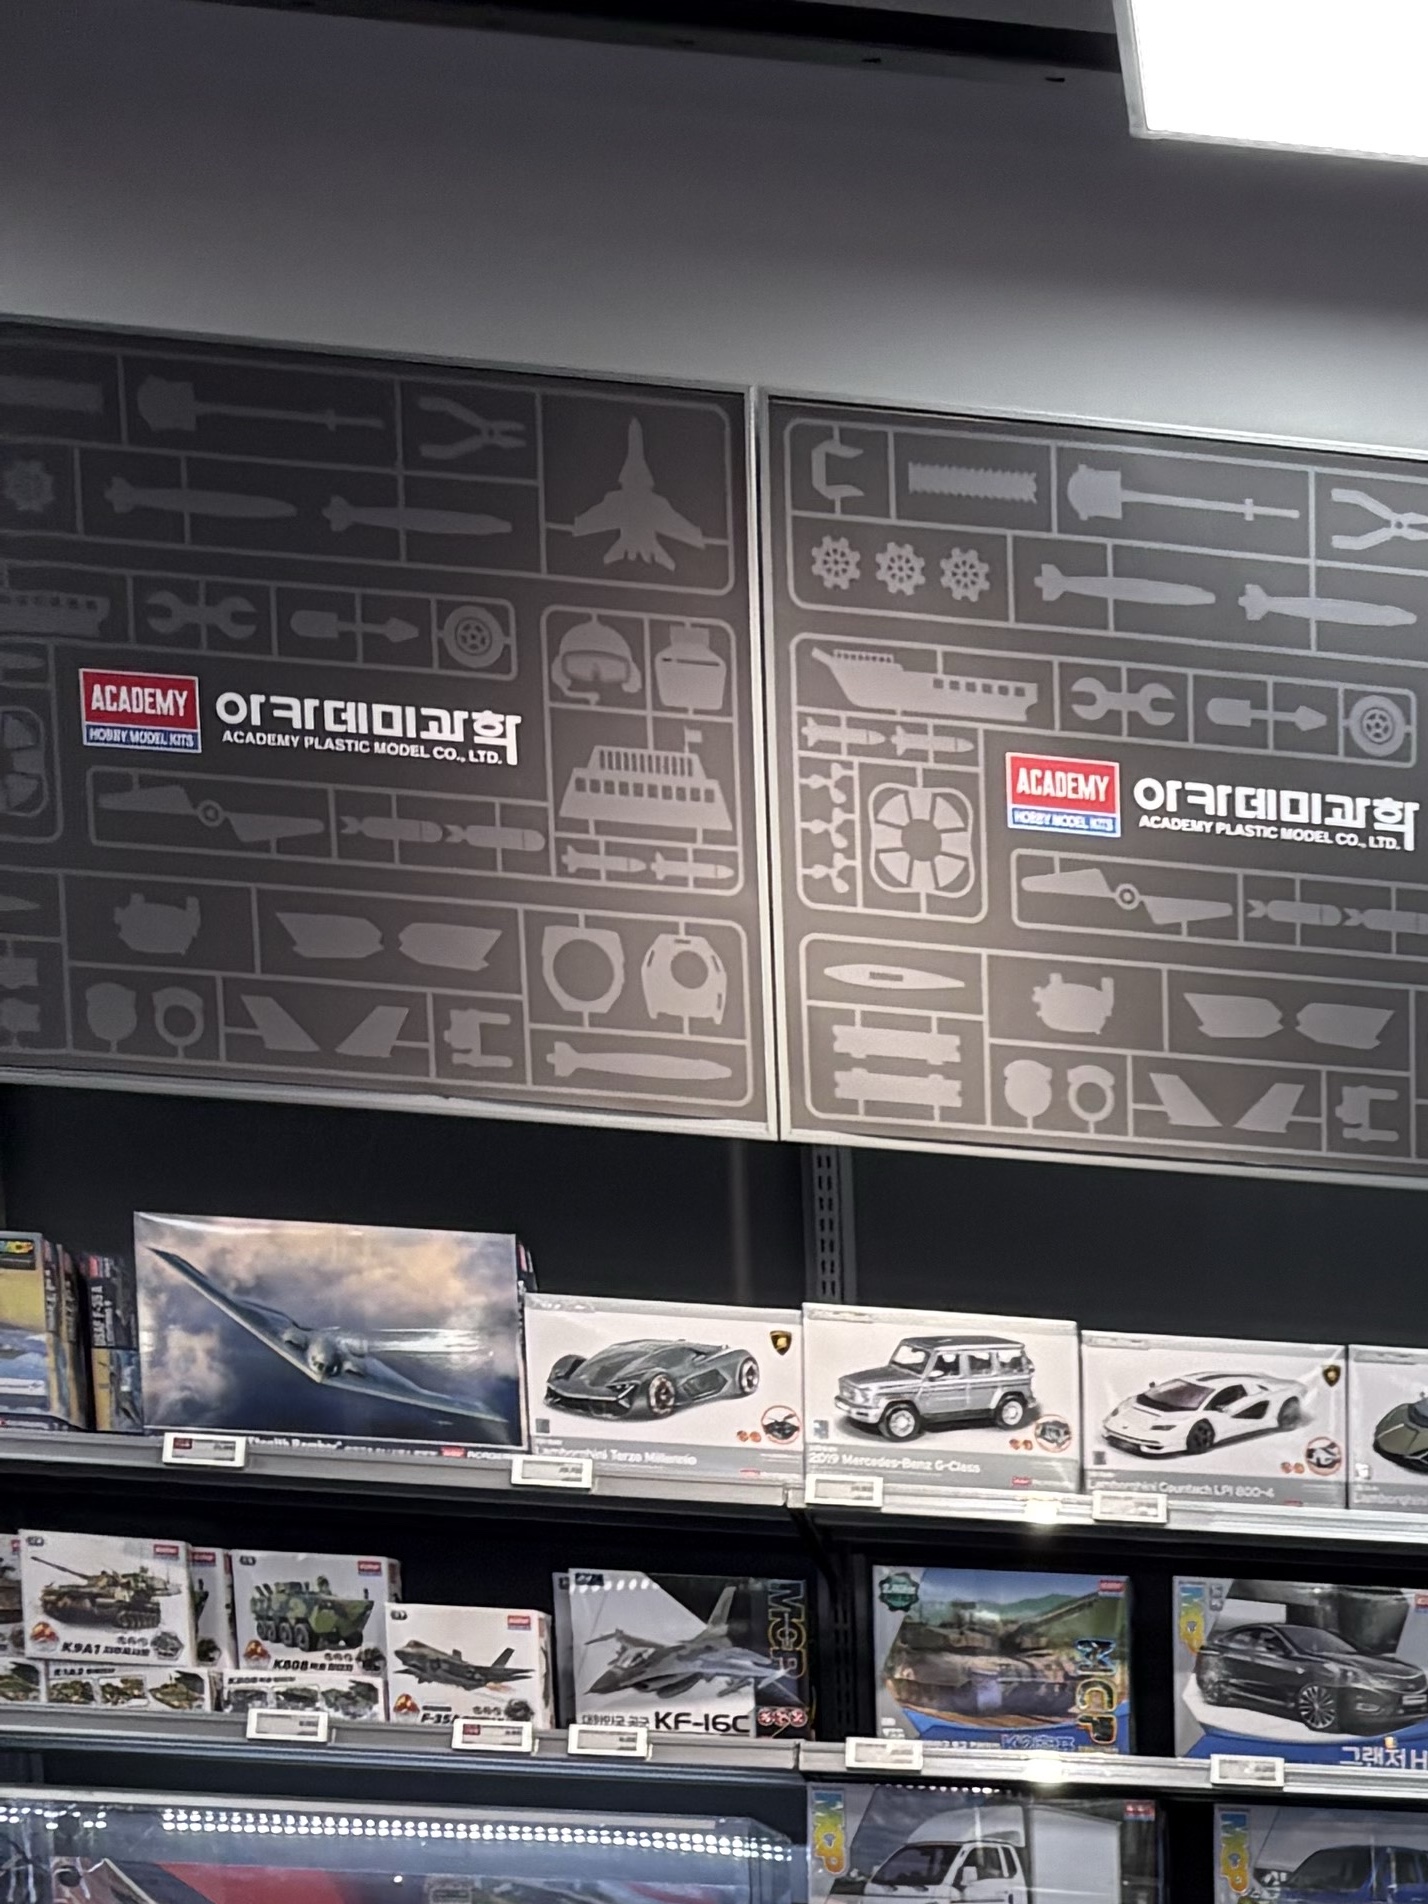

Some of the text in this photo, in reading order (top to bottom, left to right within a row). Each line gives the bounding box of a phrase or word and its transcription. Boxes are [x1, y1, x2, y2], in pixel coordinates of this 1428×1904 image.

[91, 683, 187, 717] ACADEMY
[89, 727, 194, 749] HOBBY MODEL KITS
[215, 691, 521, 766] 아카데미과학
[222, 730, 299, 749] ACADEMY
[304, 736, 370, 754] PLASTIC
[374, 741, 430, 760] MODEL
[469, 749, 503, 765] LTD.
[1017, 767, 1110, 802] ACADEMY
[1133, 777, 1420, 851] 아카데미과학
[1139, 814, 1213, 834] ACADEMY
[1215, 821, 1277, 840] PLASTIC
[1281, 827, 1333, 846] MODEL
[1368, 834, 1400, 851] LTD.
[654, 1711, 750, 1733] KF-16C
